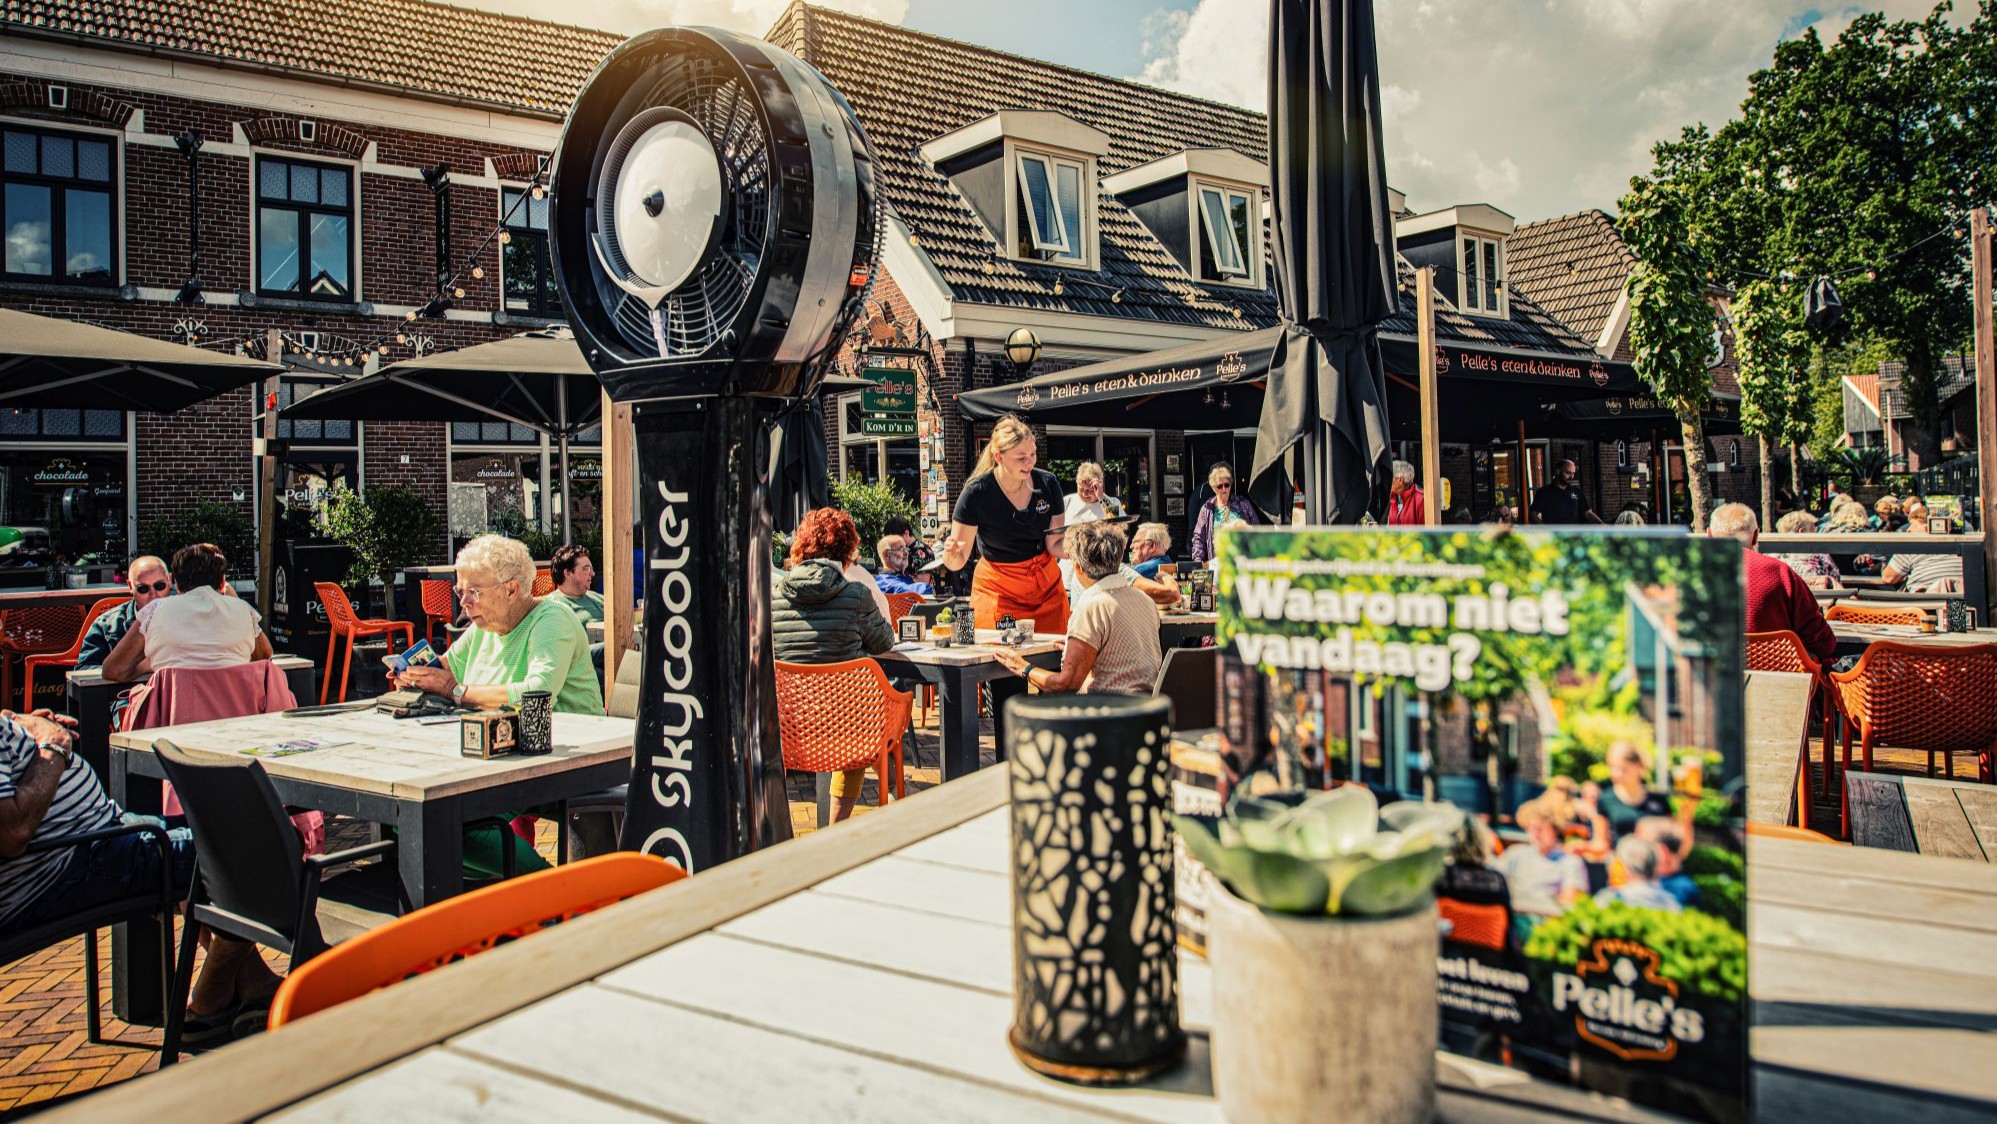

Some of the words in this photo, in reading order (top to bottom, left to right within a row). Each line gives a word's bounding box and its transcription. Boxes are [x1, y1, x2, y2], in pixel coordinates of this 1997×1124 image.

[1216, 363, 1247, 375] Pelle's
[1461, 353, 1498, 371] Pelle's
[1050, 383, 1090, 400] Pelle's
[1629, 398, 1655, 410] Pelle's
[34, 470, 89, 481] chocolade
[477, 468, 515, 478] chocolade
[285, 488, 334, 502] Pelle's
[1235, 574, 1448, 629] Waarom
[1453, 581, 1571, 636] niet
[1234, 626, 1482, 692] vandaag?
[1552, 971, 1706, 1043] Pelle's
